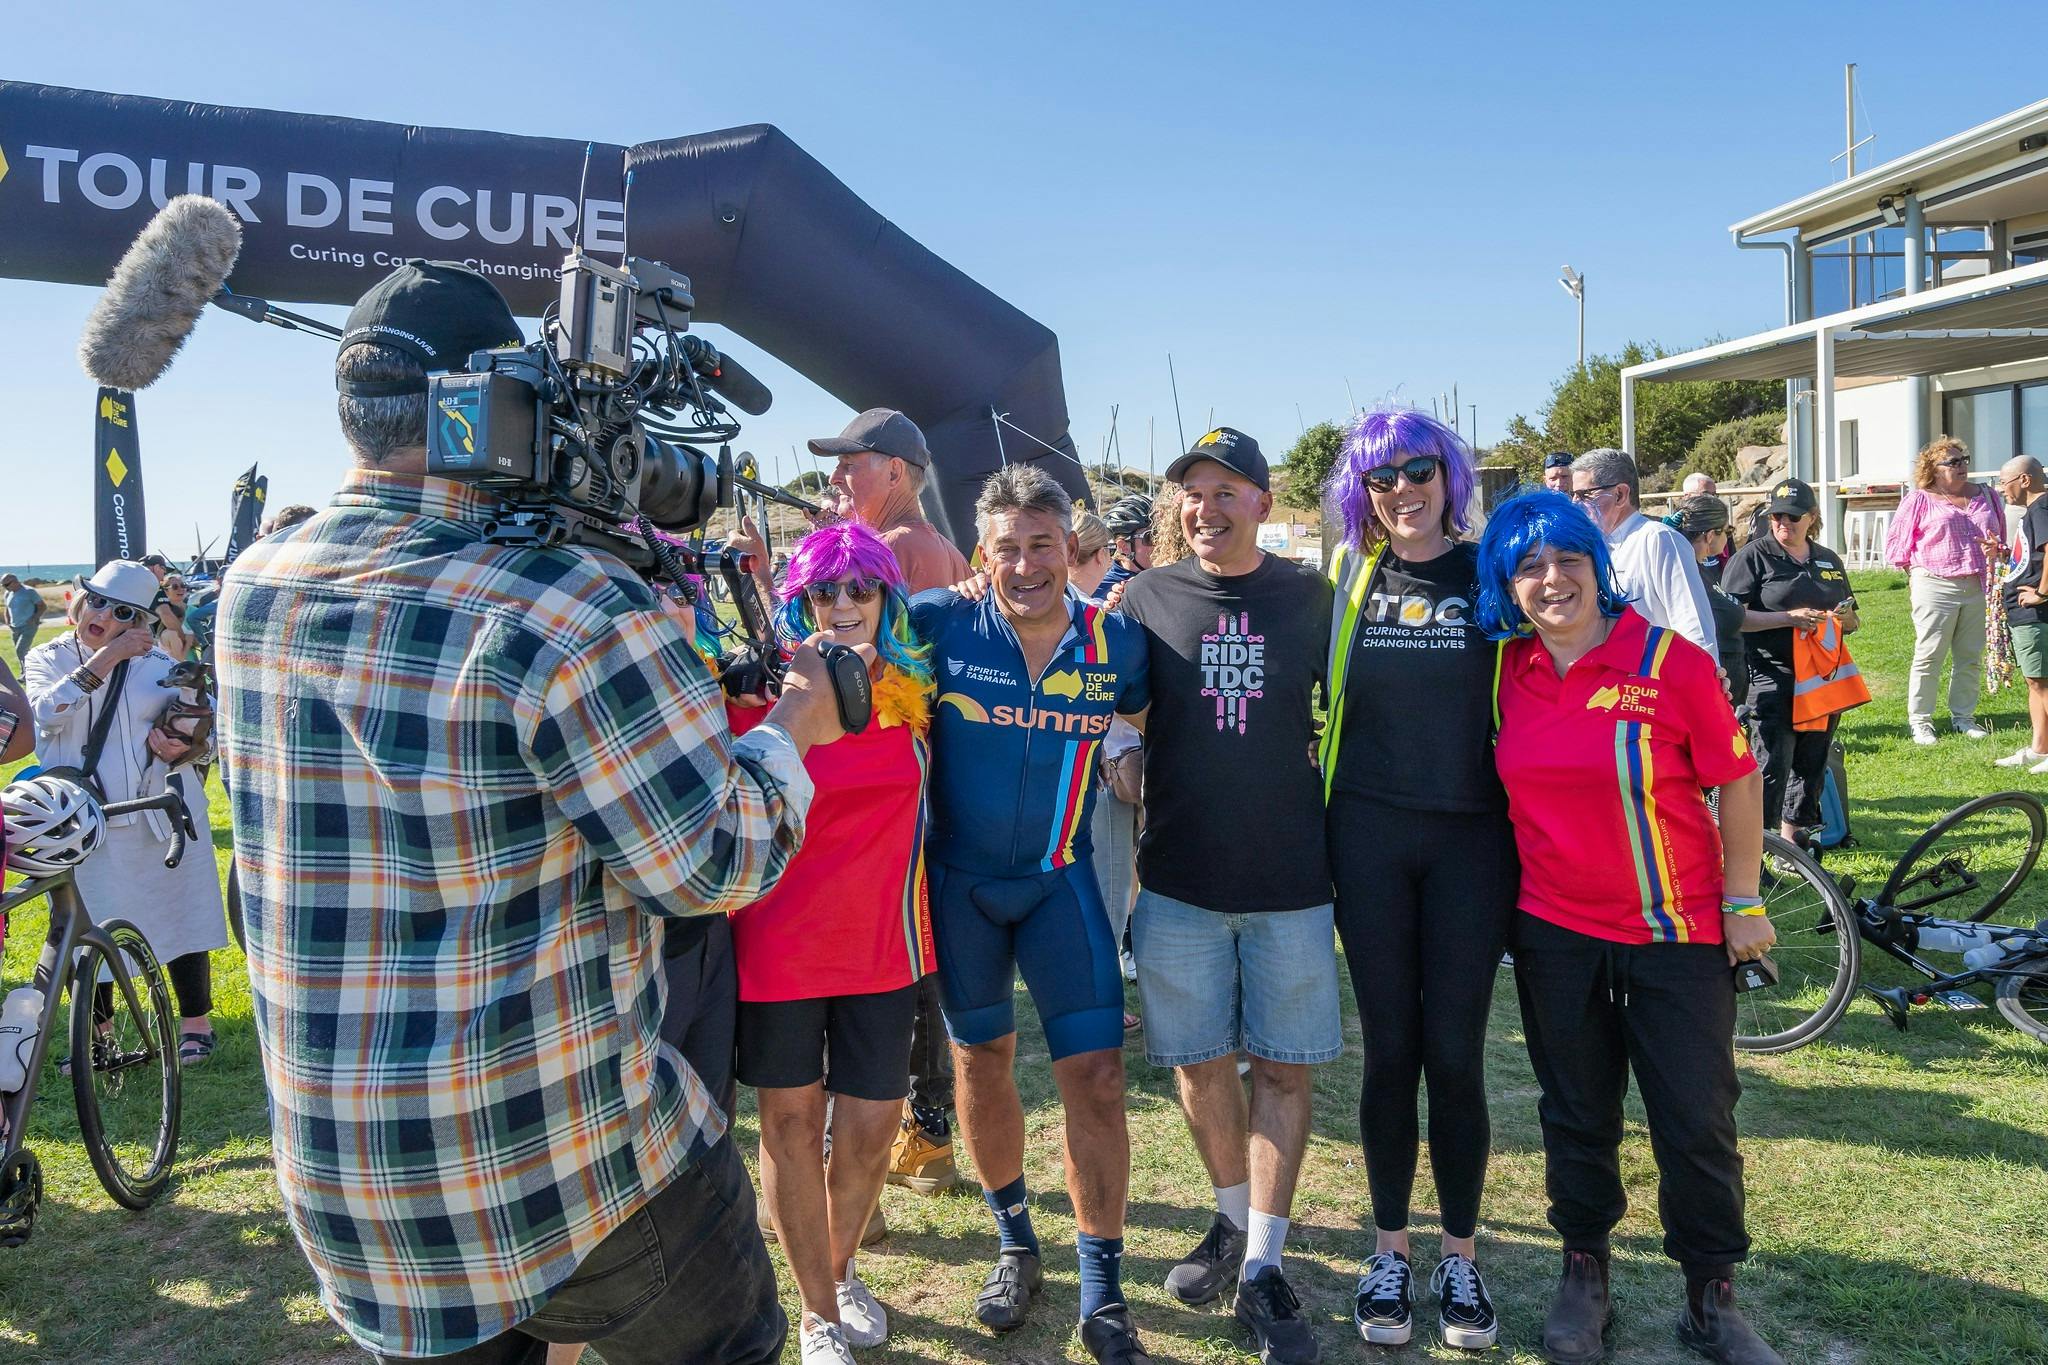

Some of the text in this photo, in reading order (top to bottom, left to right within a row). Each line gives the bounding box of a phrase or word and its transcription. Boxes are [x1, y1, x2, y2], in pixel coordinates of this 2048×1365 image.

[25, 144, 625, 254] TOUR DE CURE
[289, 244, 365, 267] Curing
[670, 279, 687, 289] SONY
[372, 325, 415, 340] CHANGING
[414, 337, 437, 357] LIVES
[1371, 592, 1469, 627] TDC
[1366, 626, 1465, 638] CURING CANCER
[1362, 638, 1466, 649] CHANGING LIVES
[1201, 643, 1265, 665] RIDE
[968, 664, 999, 676] SPIRIT
[965, 672, 1017, 687] TASMANIA
[1086, 672, 1117, 683] TOUR
[1200, 665, 1264, 690] TDC
[853, 671, 867, 704] SONY
[1086, 682, 1103, 692] DE
[1623, 684, 1658, 699] TOUR
[1086, 692, 1115, 701] CURE
[1621, 694, 1640, 705] DE
[1620, 703, 1656, 716] CURE
